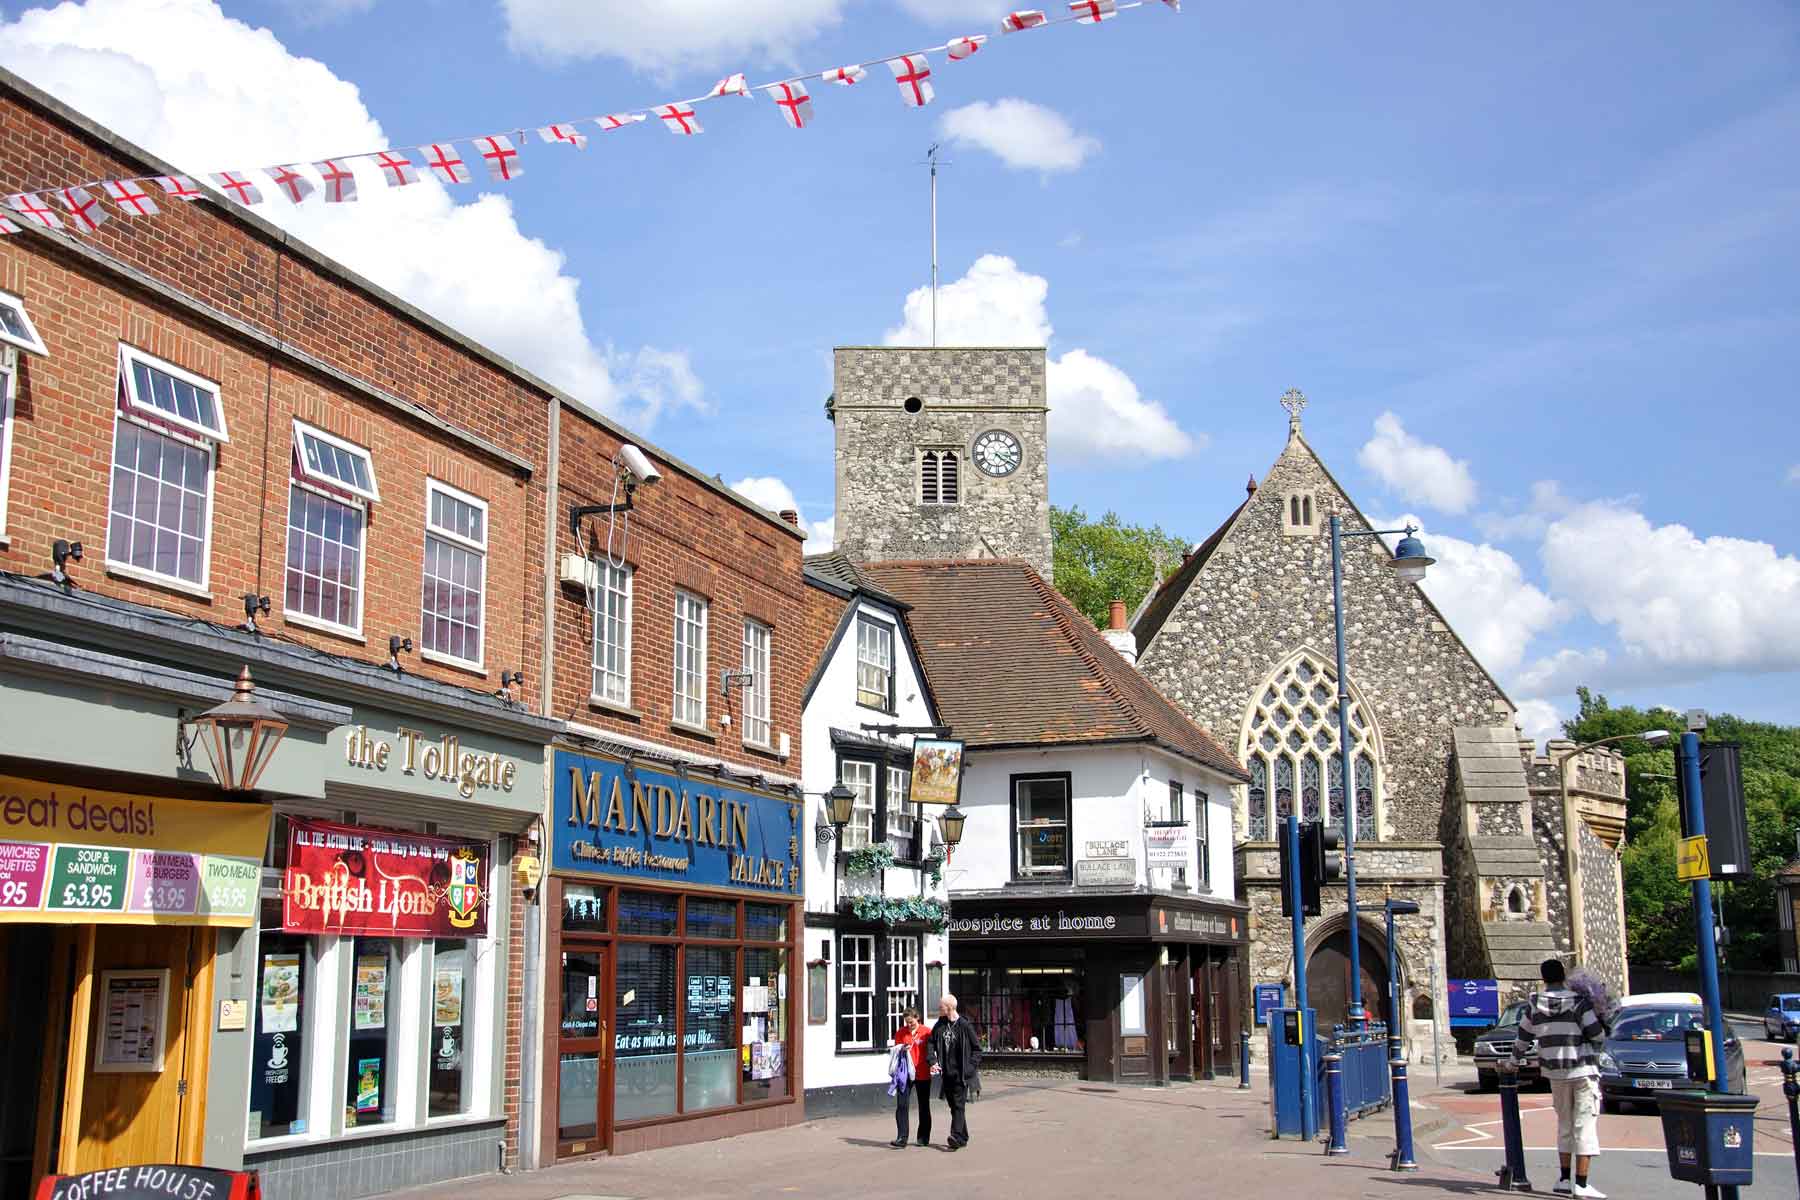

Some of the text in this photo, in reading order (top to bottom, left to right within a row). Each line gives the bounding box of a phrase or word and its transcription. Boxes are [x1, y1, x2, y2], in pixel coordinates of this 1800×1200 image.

[346, 725, 517, 798] the Tollgate
[67, 795, 154, 836] deals!
[568, 766, 749, 850] MANDARIN
[296, 831, 311, 846] ALL
[312, 832, 325, 847] THE
[326, 833, 349, 850] ACTION
[350, 836, 364, 851] LIVE
[371, 840, 390, 853] 30th
[391, 842, 407, 858] May
[409, 844, 417, 856] to
[419, 845, 432, 858] 4th
[433, 846, 449, 861] July
[571, 840, 611, 861] Chinese
[1088, 840, 1126, 849] BULLACE
[78, 850, 110, 863] SOUP &
[143, 854, 194, 868] MAIN MEALS
[67, 862, 117, 876] SANDWICH
[145, 868, 190, 880] & BURGERS
[208, 864, 257, 880] TWO MEALS
[731, 854, 784, 887] PALACE
[63, 883, 112, 907] £3.95
[143, 886, 185, 909] £3.95
[294, 868, 436, 924] British Lions
[1030, 914, 1050, 931] at
[1058, 910, 1116, 931] home
[615, 1034, 630, 1049] Eat
[631, 1036, 641, 1048] as
[643, 1031, 665, 1048] much
[667, 1034, 677, 1046] as
